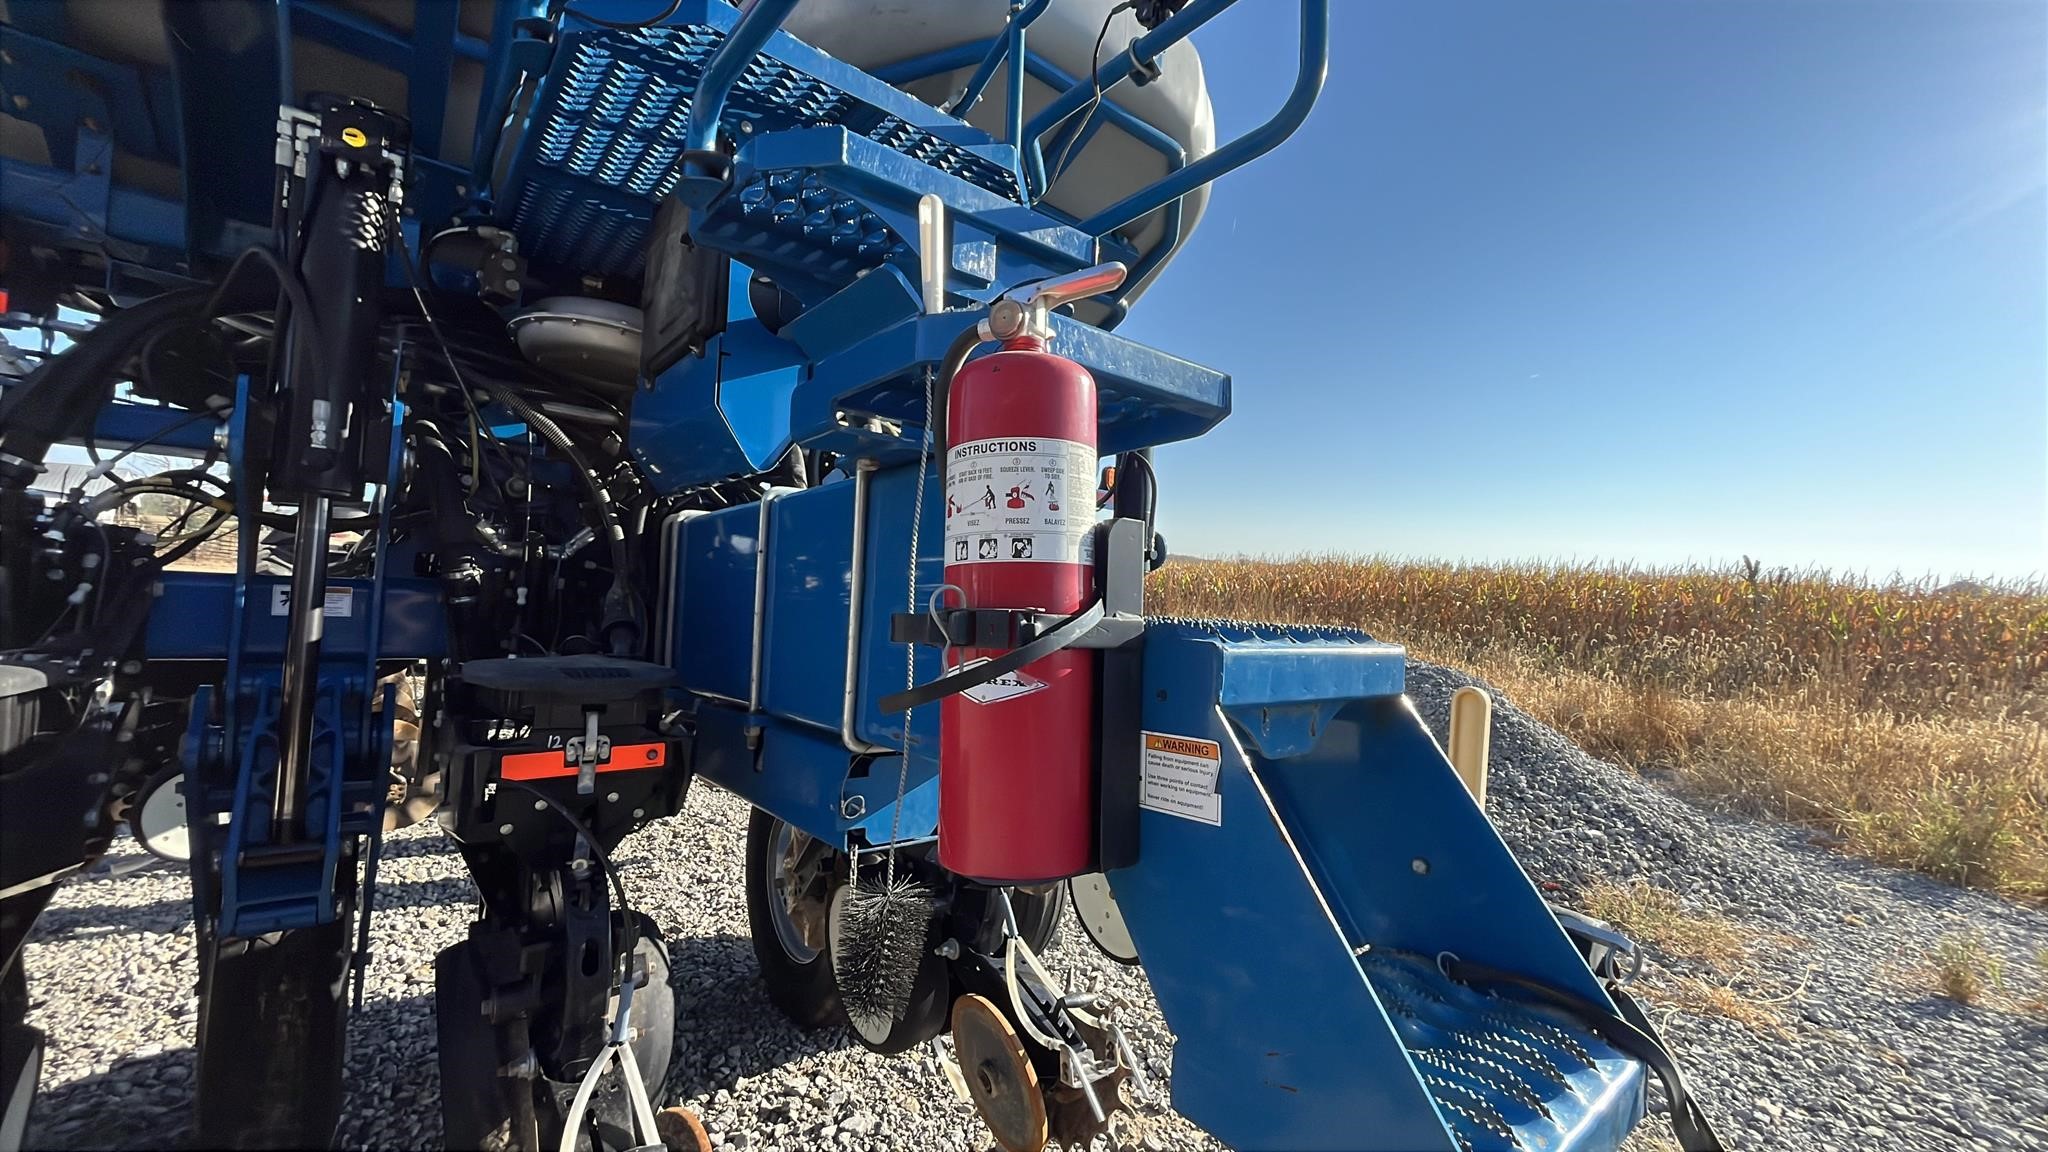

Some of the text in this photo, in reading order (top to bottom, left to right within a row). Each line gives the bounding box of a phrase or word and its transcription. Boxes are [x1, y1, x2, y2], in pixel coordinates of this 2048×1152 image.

[955, 441, 1037, 459] INSTRUCTIONS
[1005, 517, 1030, 525] PRESSEZ
[547, 735, 563, 749] 12
[1162, 739, 1209, 756] WARNING
[1148, 752, 1163, 761] Falling
[1175, 758, 1199, 767] equipment
[1190, 782, 1209, 790] contact
